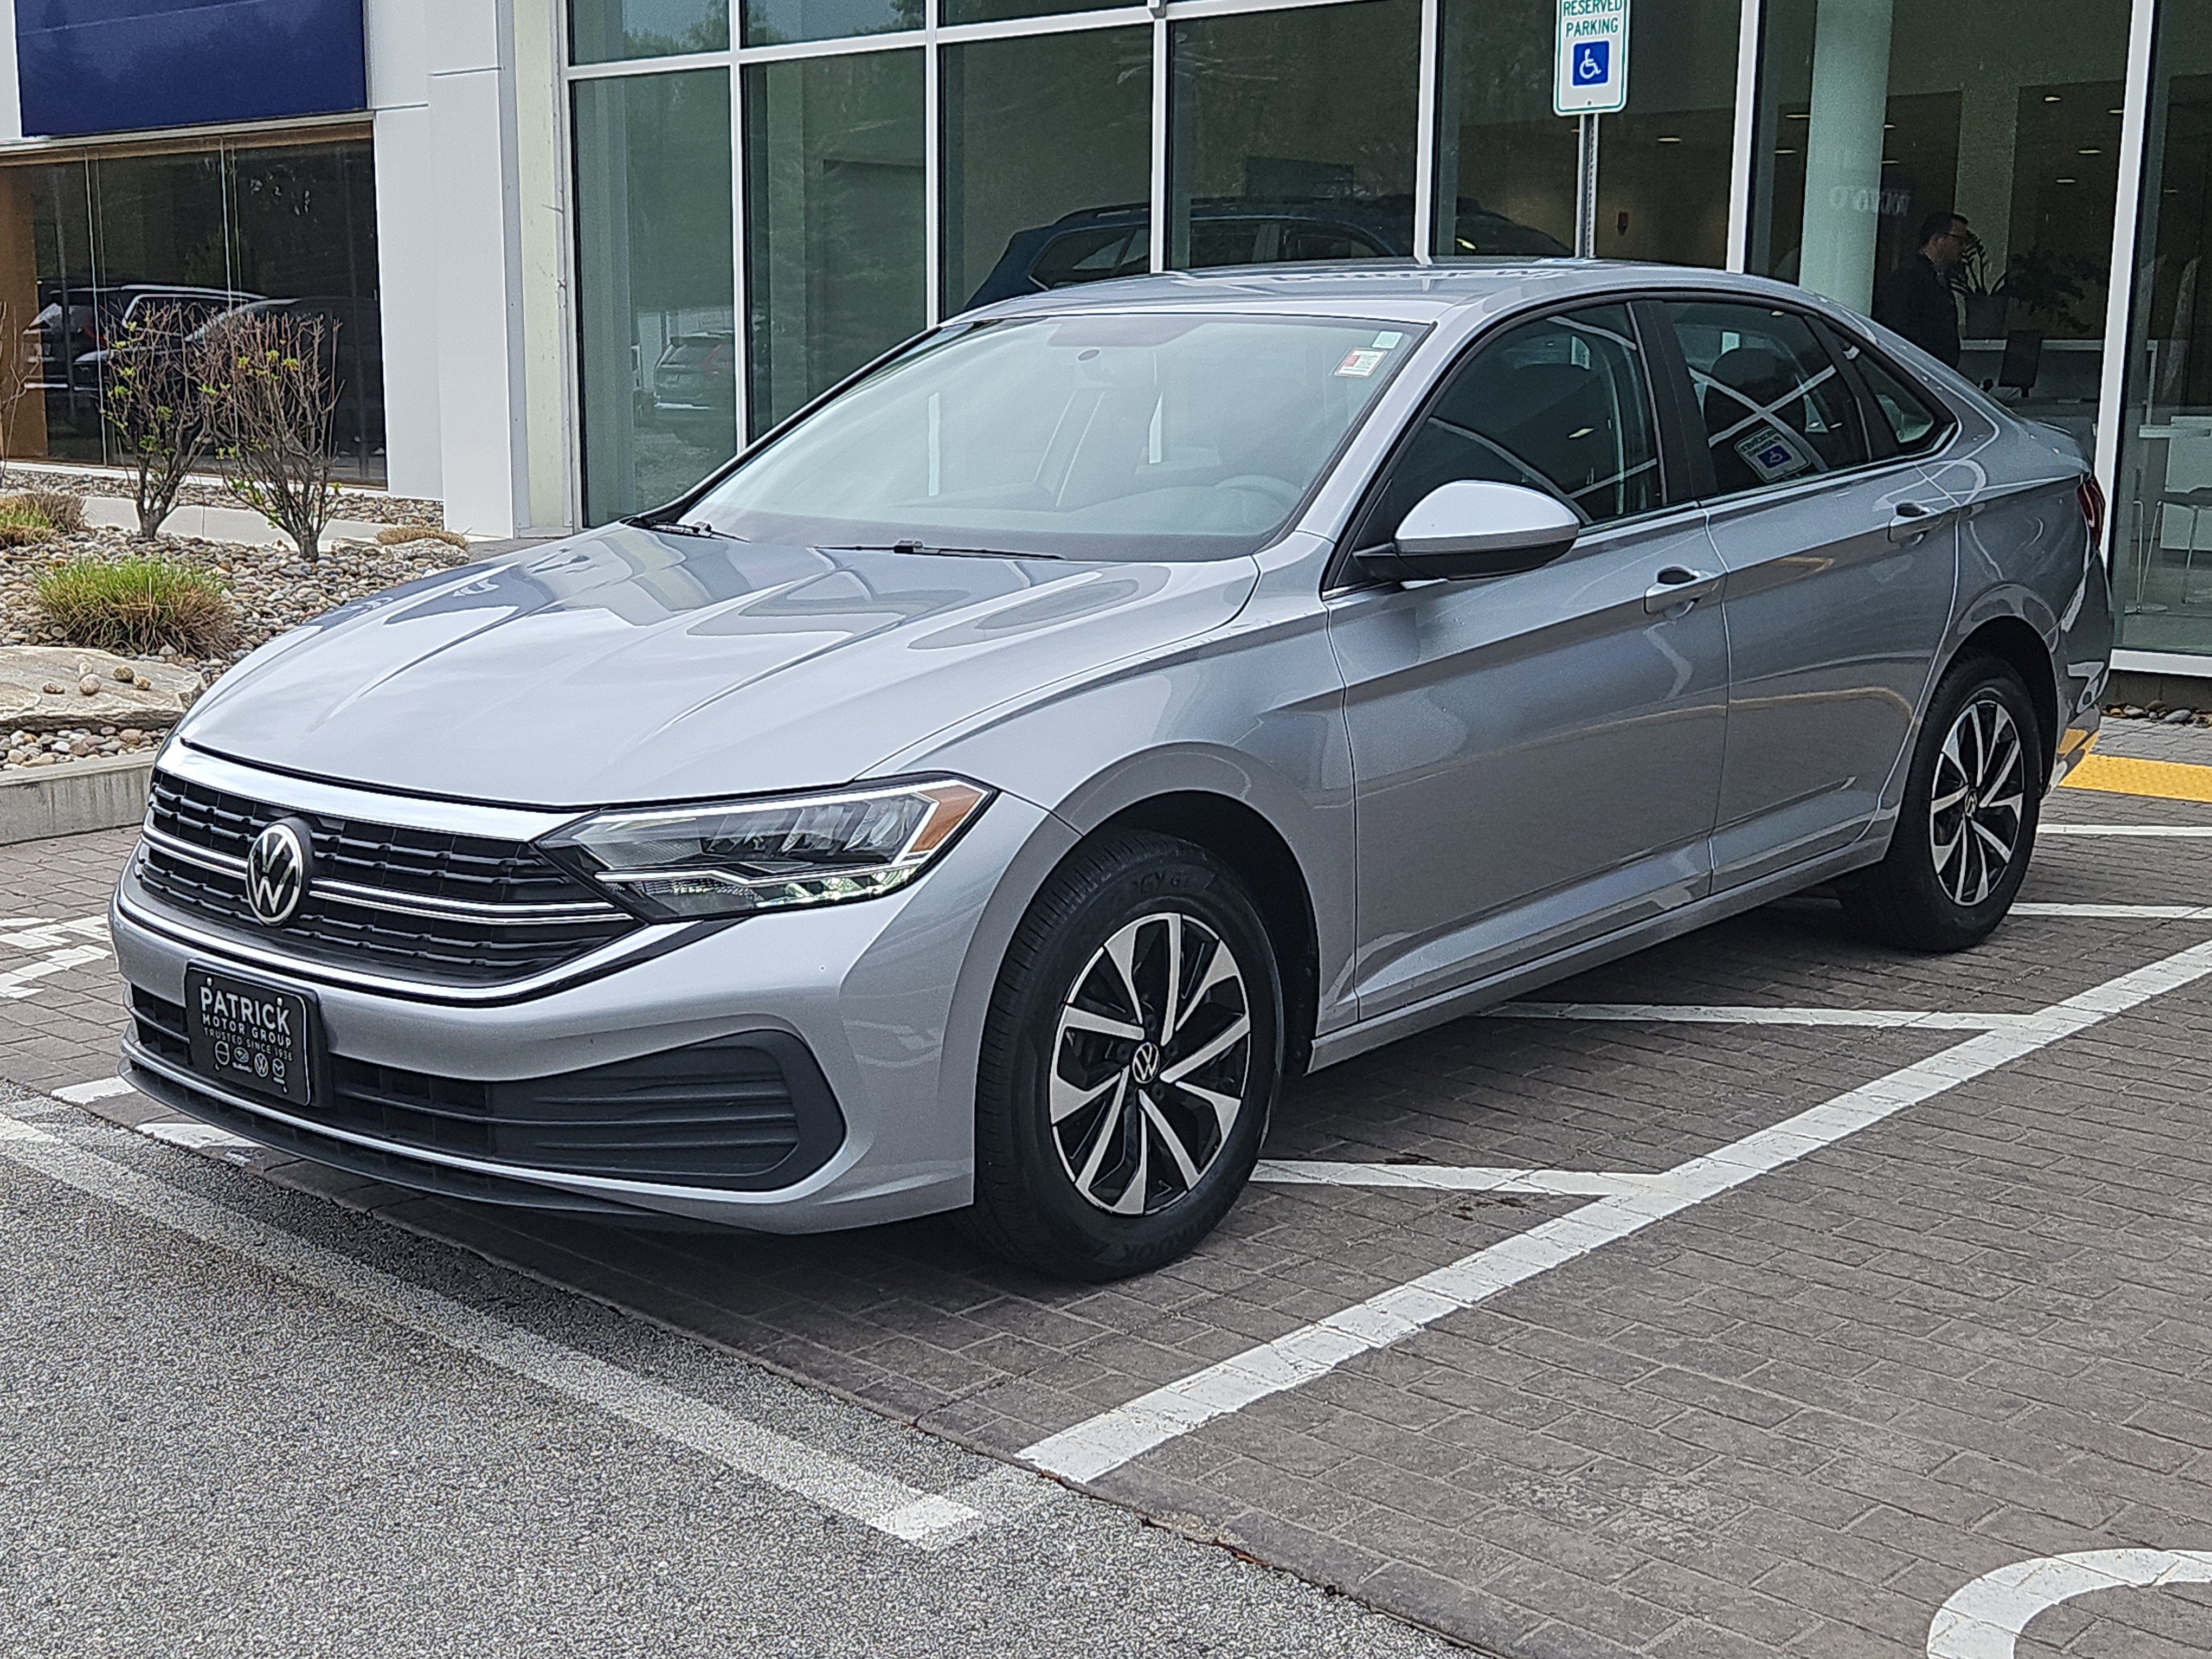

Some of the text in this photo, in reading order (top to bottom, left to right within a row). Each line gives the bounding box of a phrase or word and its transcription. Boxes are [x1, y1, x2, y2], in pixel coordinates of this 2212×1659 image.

[1563, 0, 1622, 17] RESERVED
[1566, 17, 1618, 37] PARKING
[200, 986, 291, 1036] PATRICK
[202, 1013, 292, 1049] MOTOR GROUP
[204, 1026, 242, 1045] TRUSTED
[246, 1038, 271, 1054] SINCE
